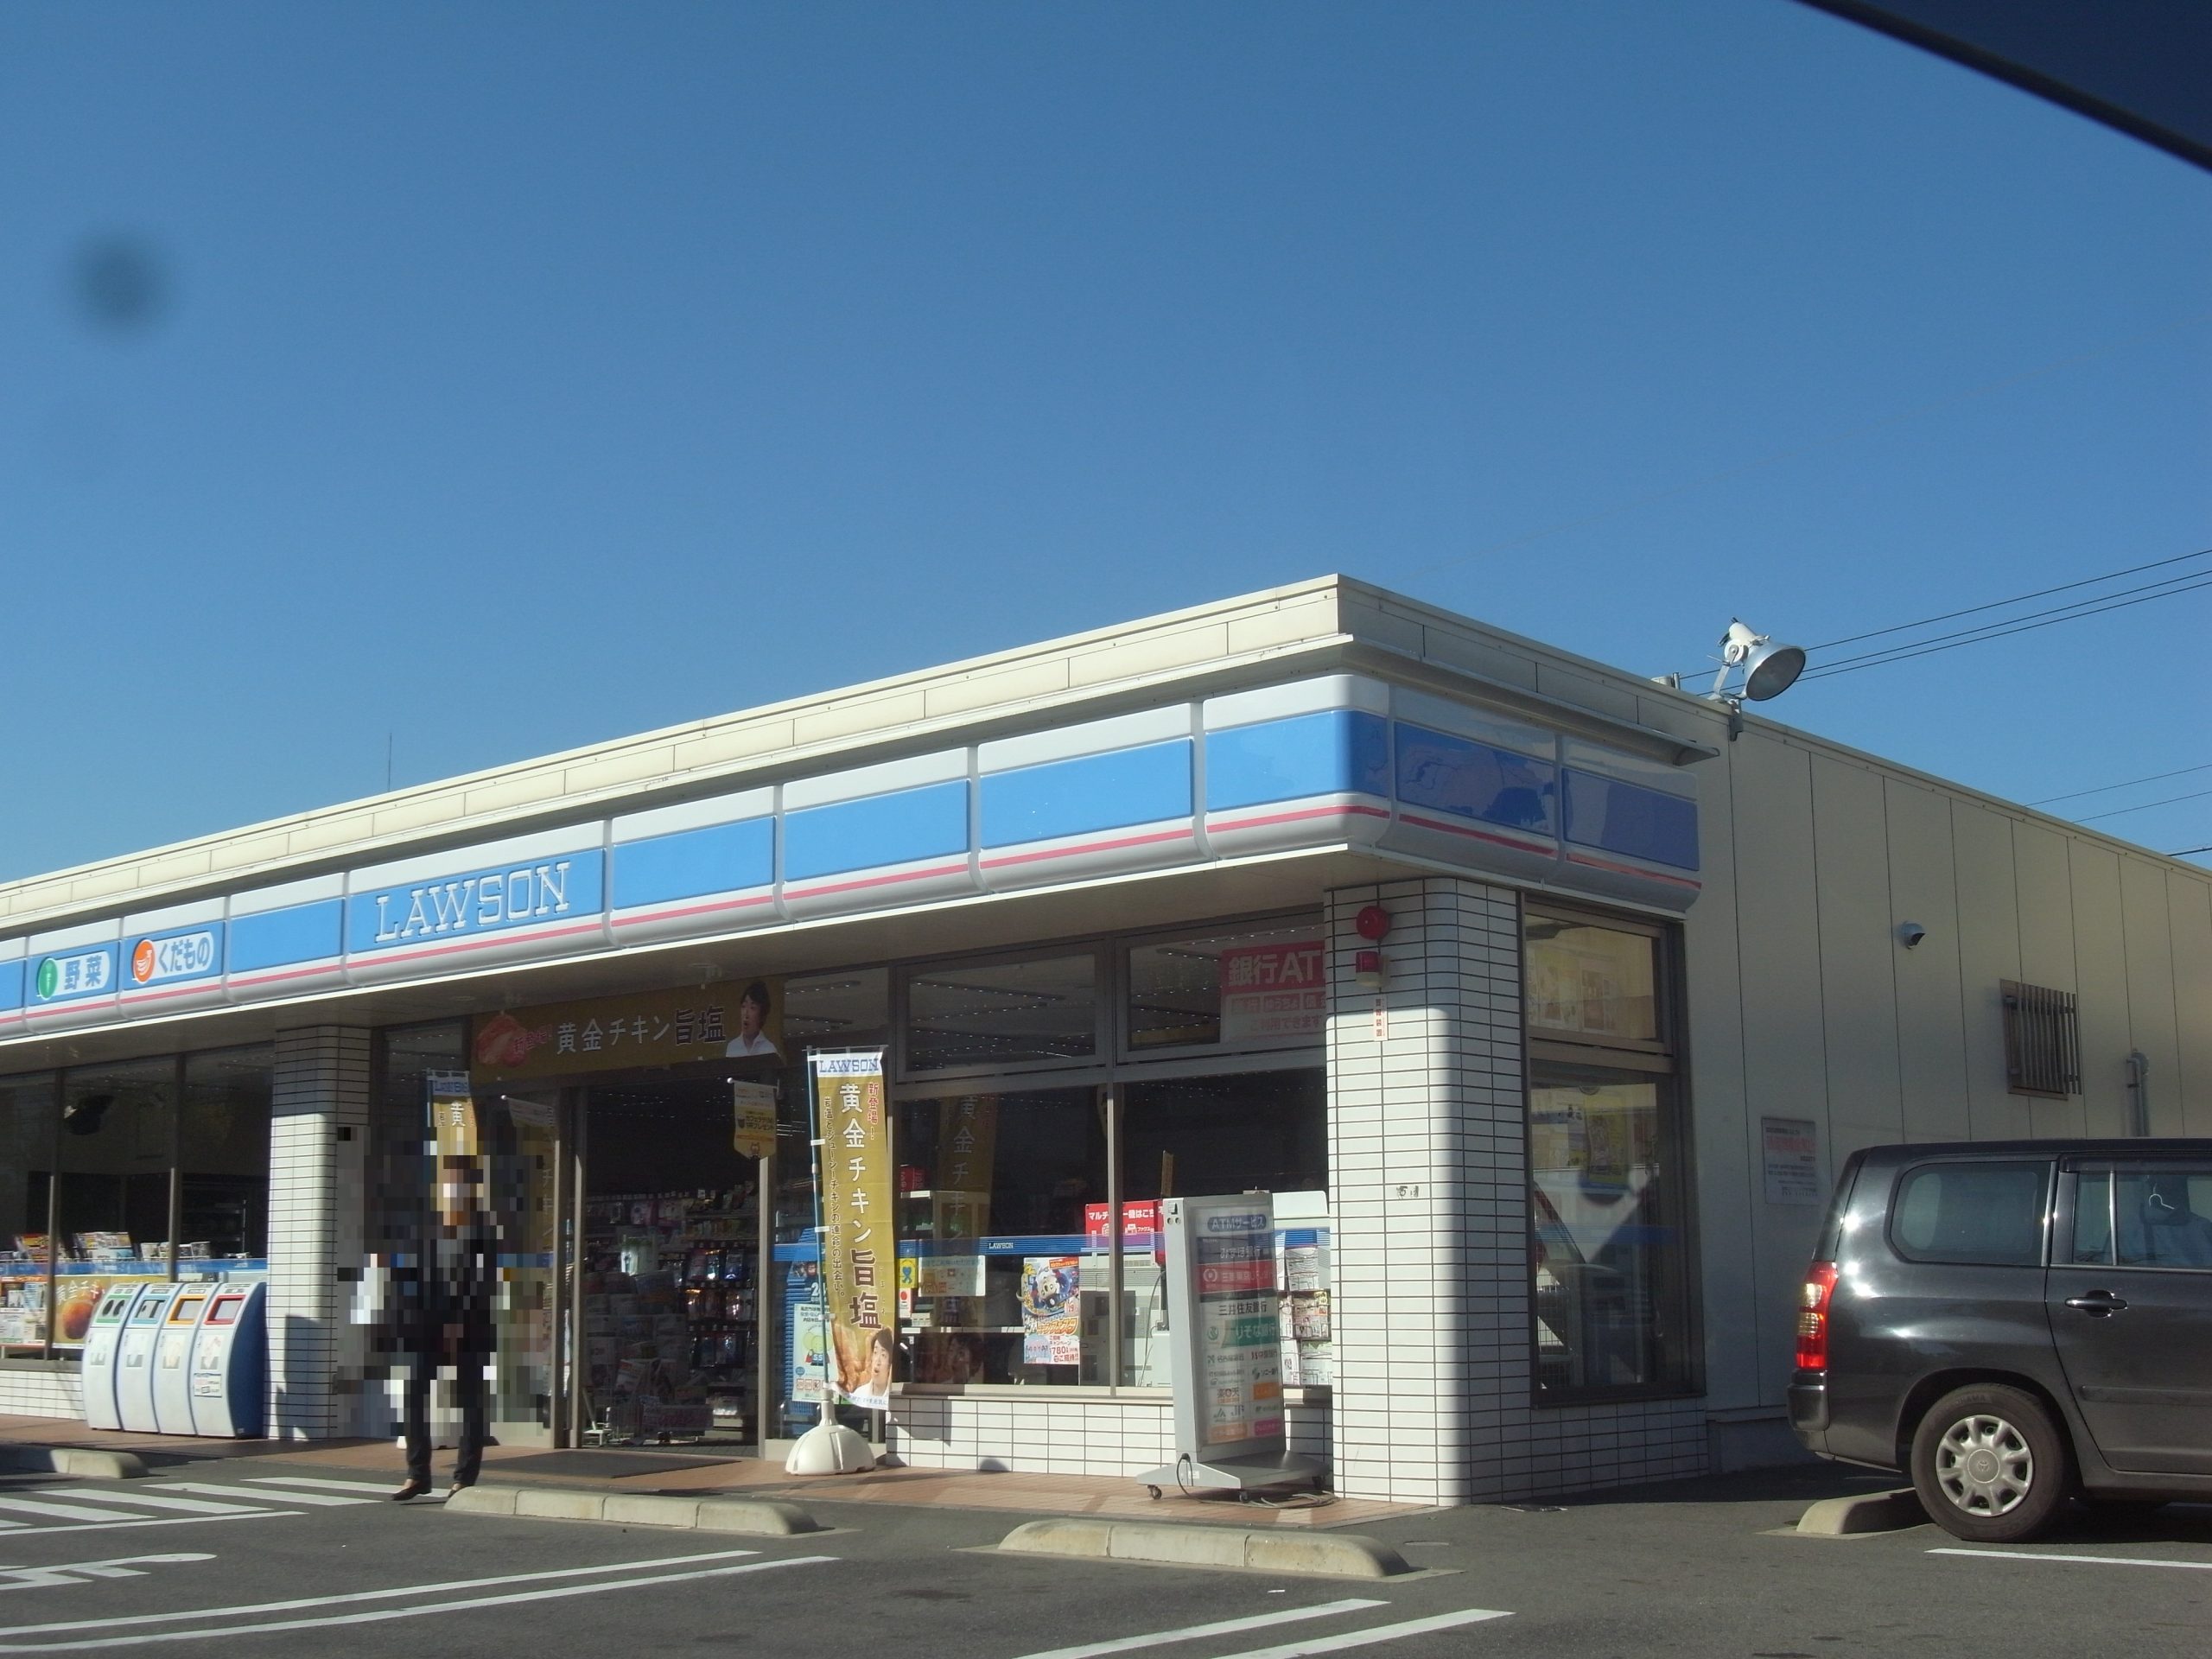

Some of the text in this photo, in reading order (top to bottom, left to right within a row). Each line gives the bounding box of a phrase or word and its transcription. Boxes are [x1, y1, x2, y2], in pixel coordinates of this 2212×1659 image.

[374, 861, 570, 943] LAWSON
[64, 955, 103, 990] 野菜
[158, 937, 211, 973] くだもの
[1228, 949, 1325, 987] 銀行AT
[556, 1004, 727, 1056] 黄金チキン旨塩
[819, 1058, 880, 1073] LAWSON
[839, 1083, 882, 1331] 黄金チキン旨塩
[1211, 1216, 1264, 1230] ATMサービス
[1218, 1300, 1268, 1316] 三井住友銀行
